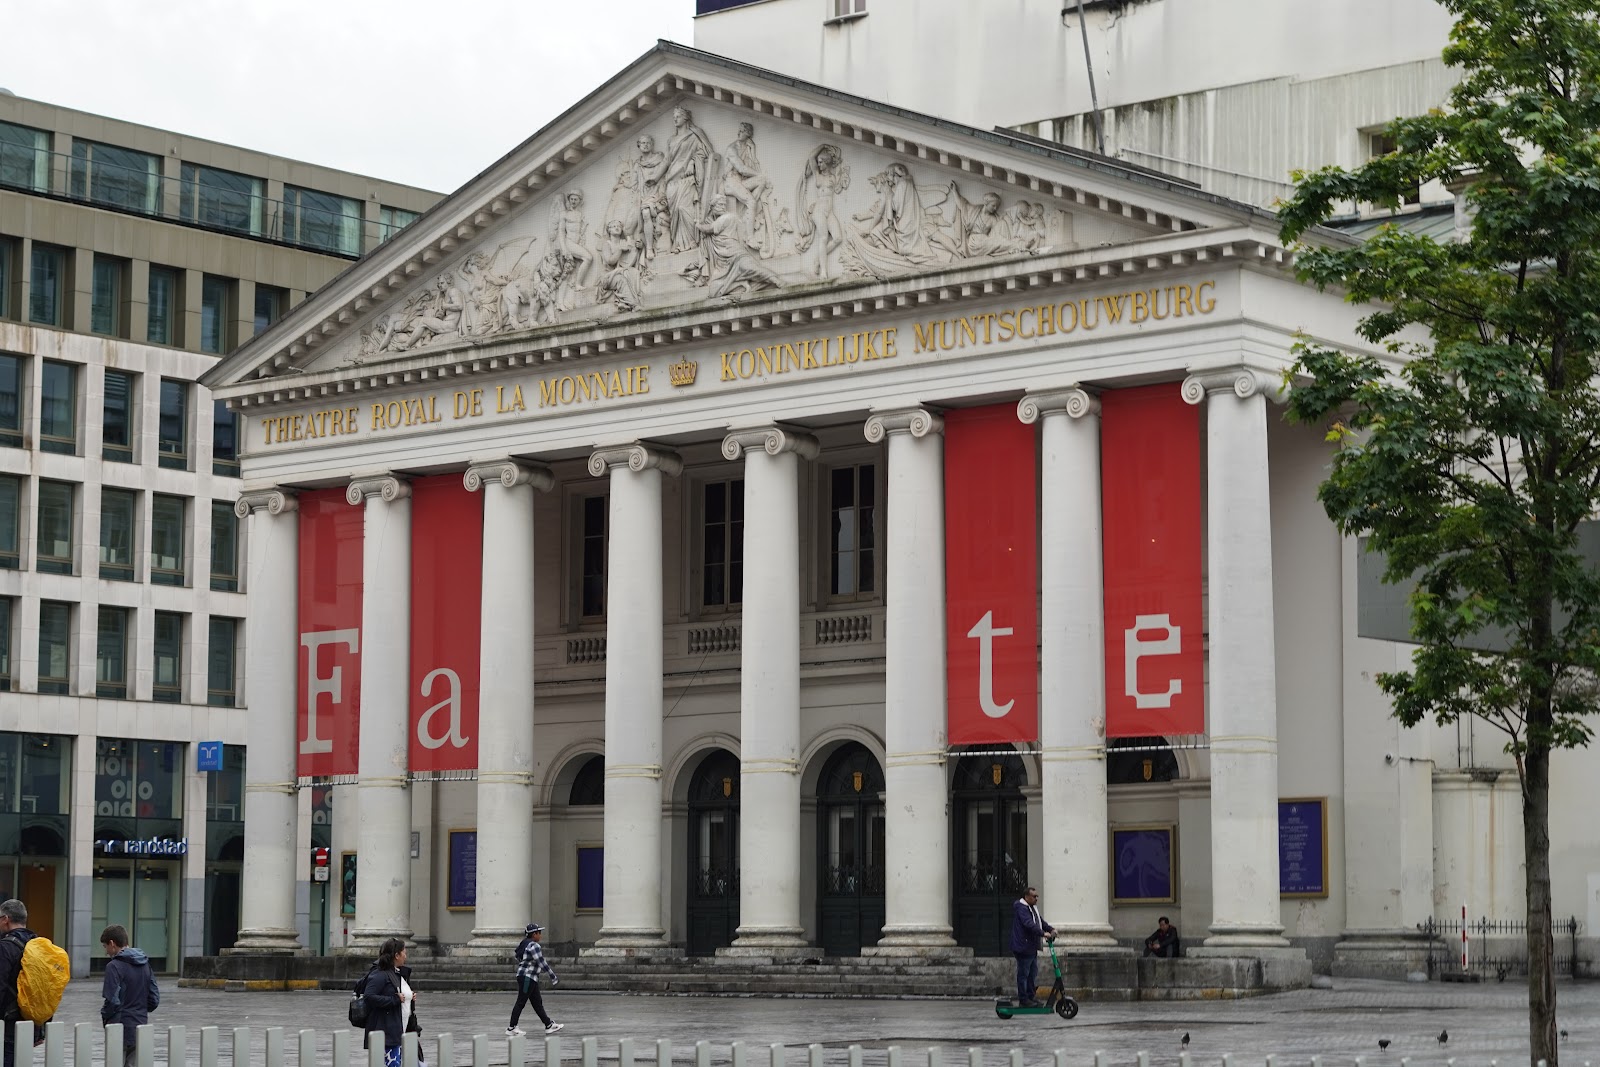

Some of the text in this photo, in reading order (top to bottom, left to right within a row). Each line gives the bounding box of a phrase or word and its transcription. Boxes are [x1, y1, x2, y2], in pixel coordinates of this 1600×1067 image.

[720, 280, 1216, 382] KONINKLIJKE MUNTSCHOUWBURG
[261, 365, 651, 444] THEATRE ROYAL DE LA MONNAIE
[300, 628, 359, 754] F
[417, 668, 470, 749] a
[967, 609, 1015, 718] t
[1125, 613, 1182, 709] e
[124, 837, 188, 854] randstad
